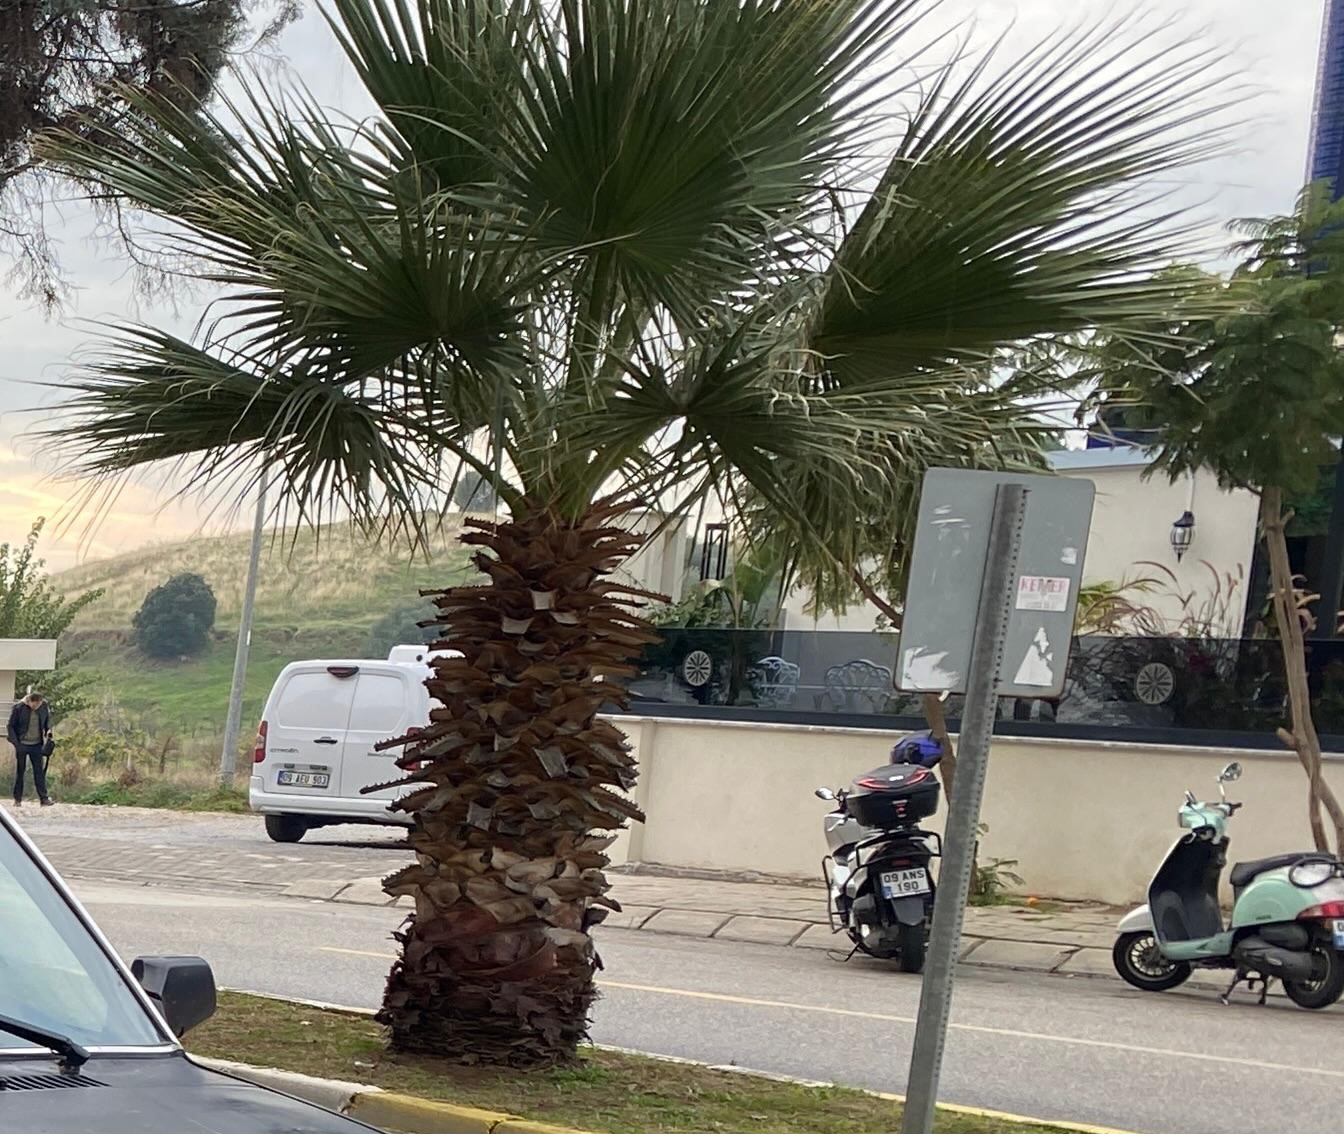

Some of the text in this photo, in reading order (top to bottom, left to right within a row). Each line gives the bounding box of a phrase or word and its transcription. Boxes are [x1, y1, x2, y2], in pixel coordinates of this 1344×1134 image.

[883, 869, 925, 883] 09 ANS
[897, 881, 919, 891] 190
